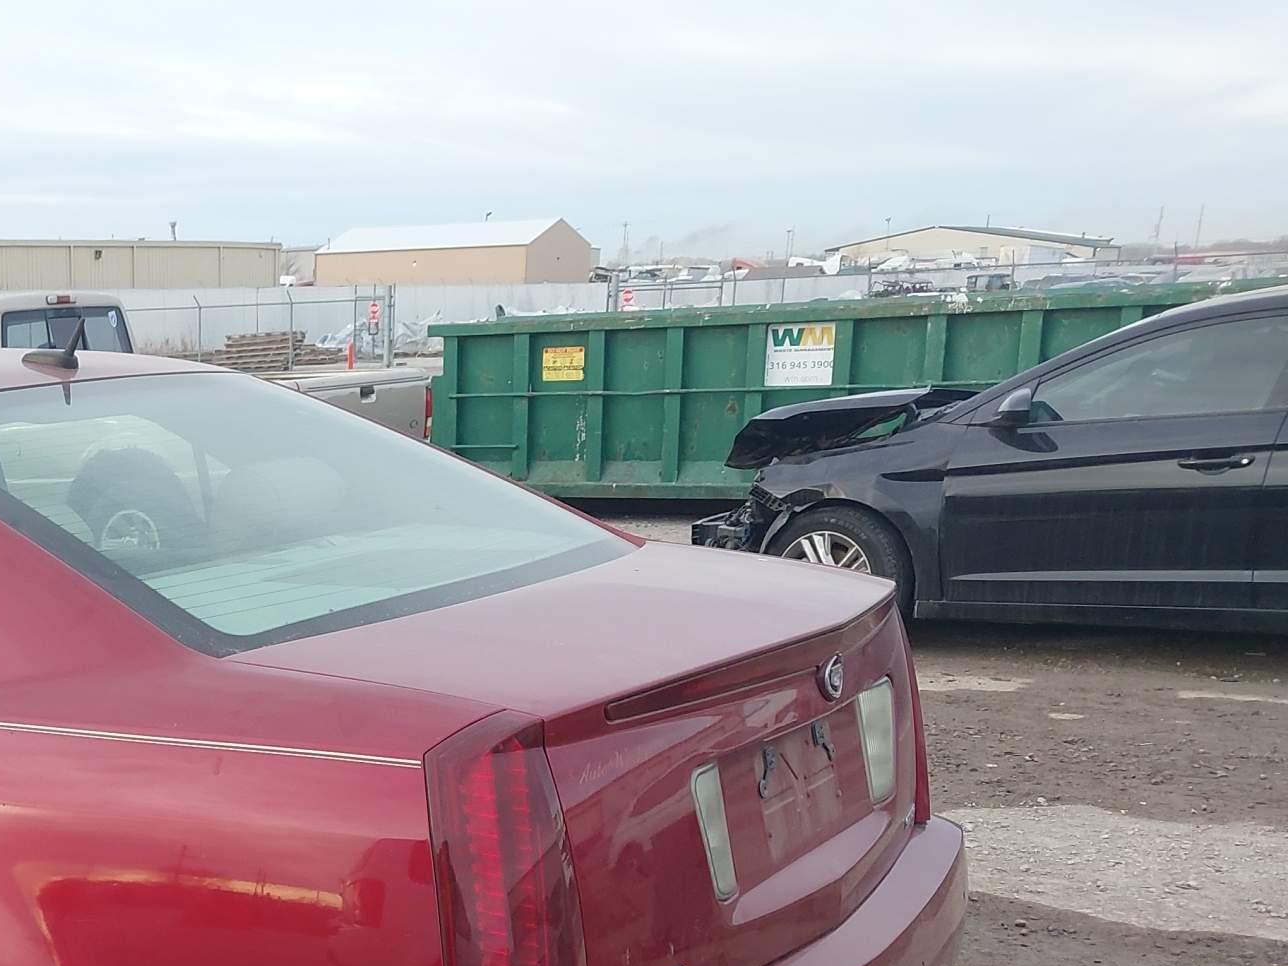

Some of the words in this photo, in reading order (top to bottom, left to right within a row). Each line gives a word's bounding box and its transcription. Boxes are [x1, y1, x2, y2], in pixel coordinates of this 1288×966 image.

[772, 327, 834, 347] WM
[769, 360, 787, 370] 316
[789, 360, 808, 369] 945
